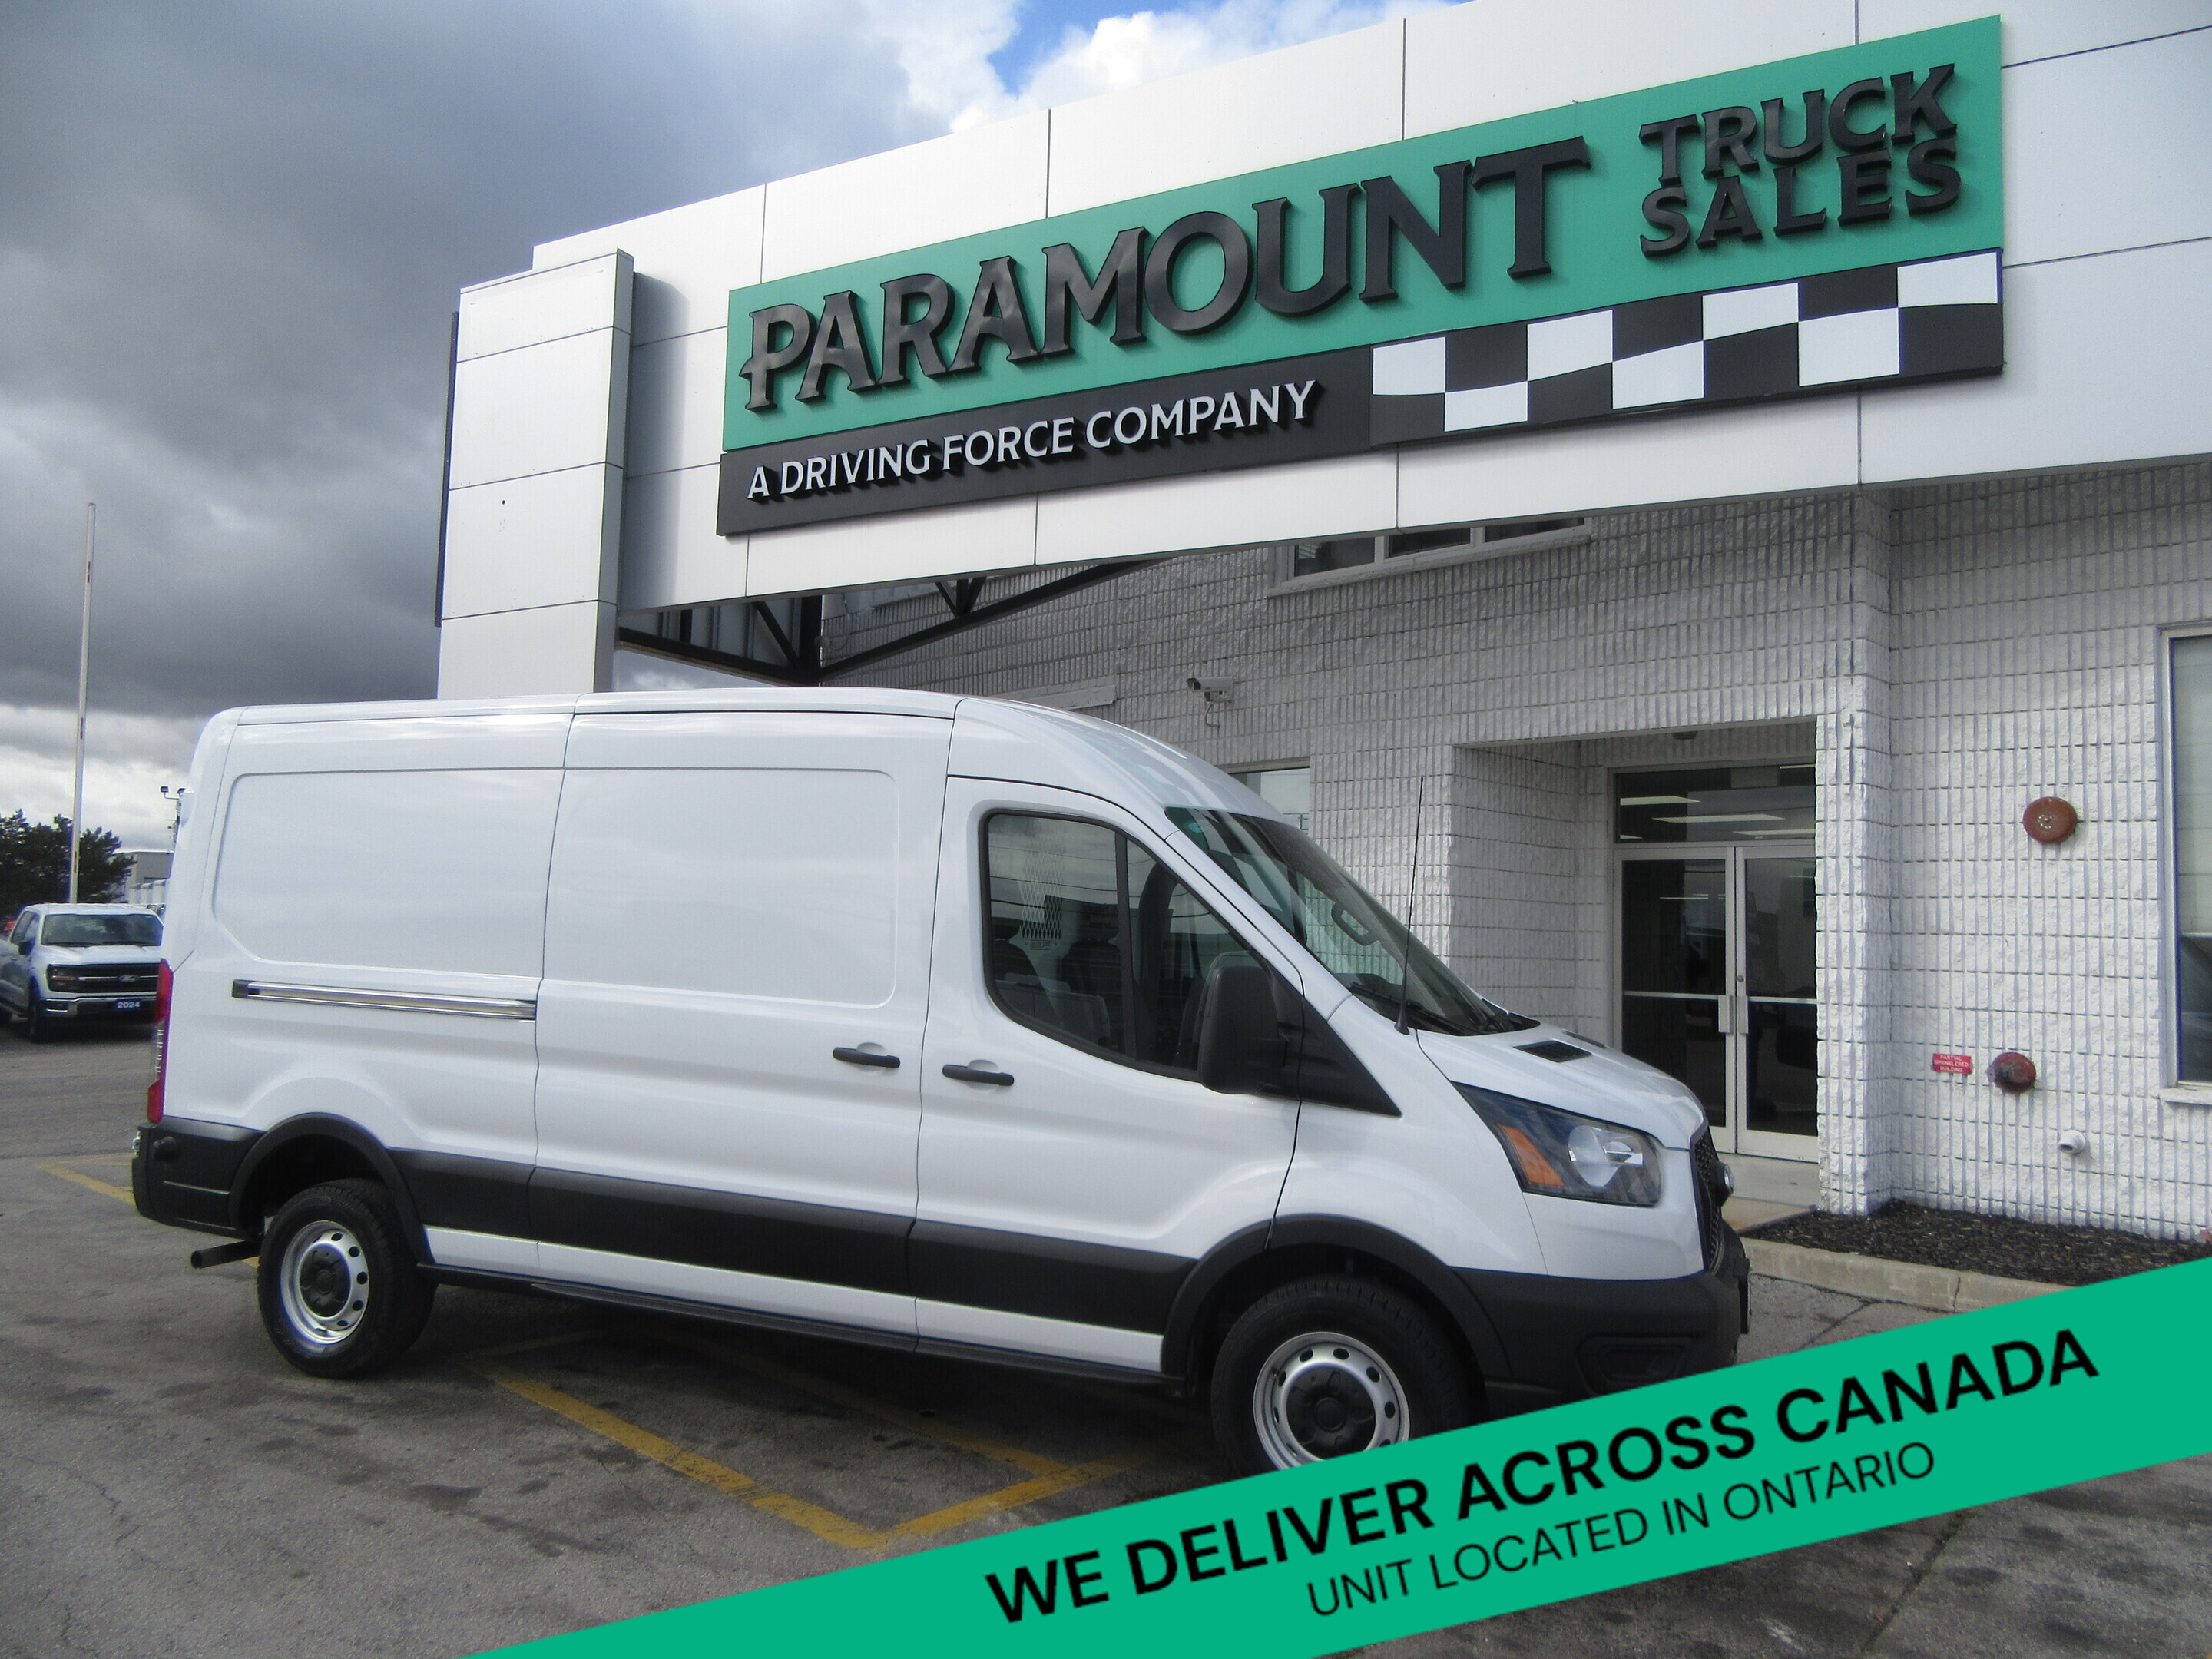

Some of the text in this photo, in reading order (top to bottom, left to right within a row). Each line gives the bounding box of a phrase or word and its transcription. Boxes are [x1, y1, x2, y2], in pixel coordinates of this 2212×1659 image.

[1639, 63, 1957, 187] TRUCK
[1639, 139, 1961, 258] SALES
[739, 136, 1592, 412] PARAMOUNT
[747, 380, 1316, 499] A DRIVING FORCE COMPANY
